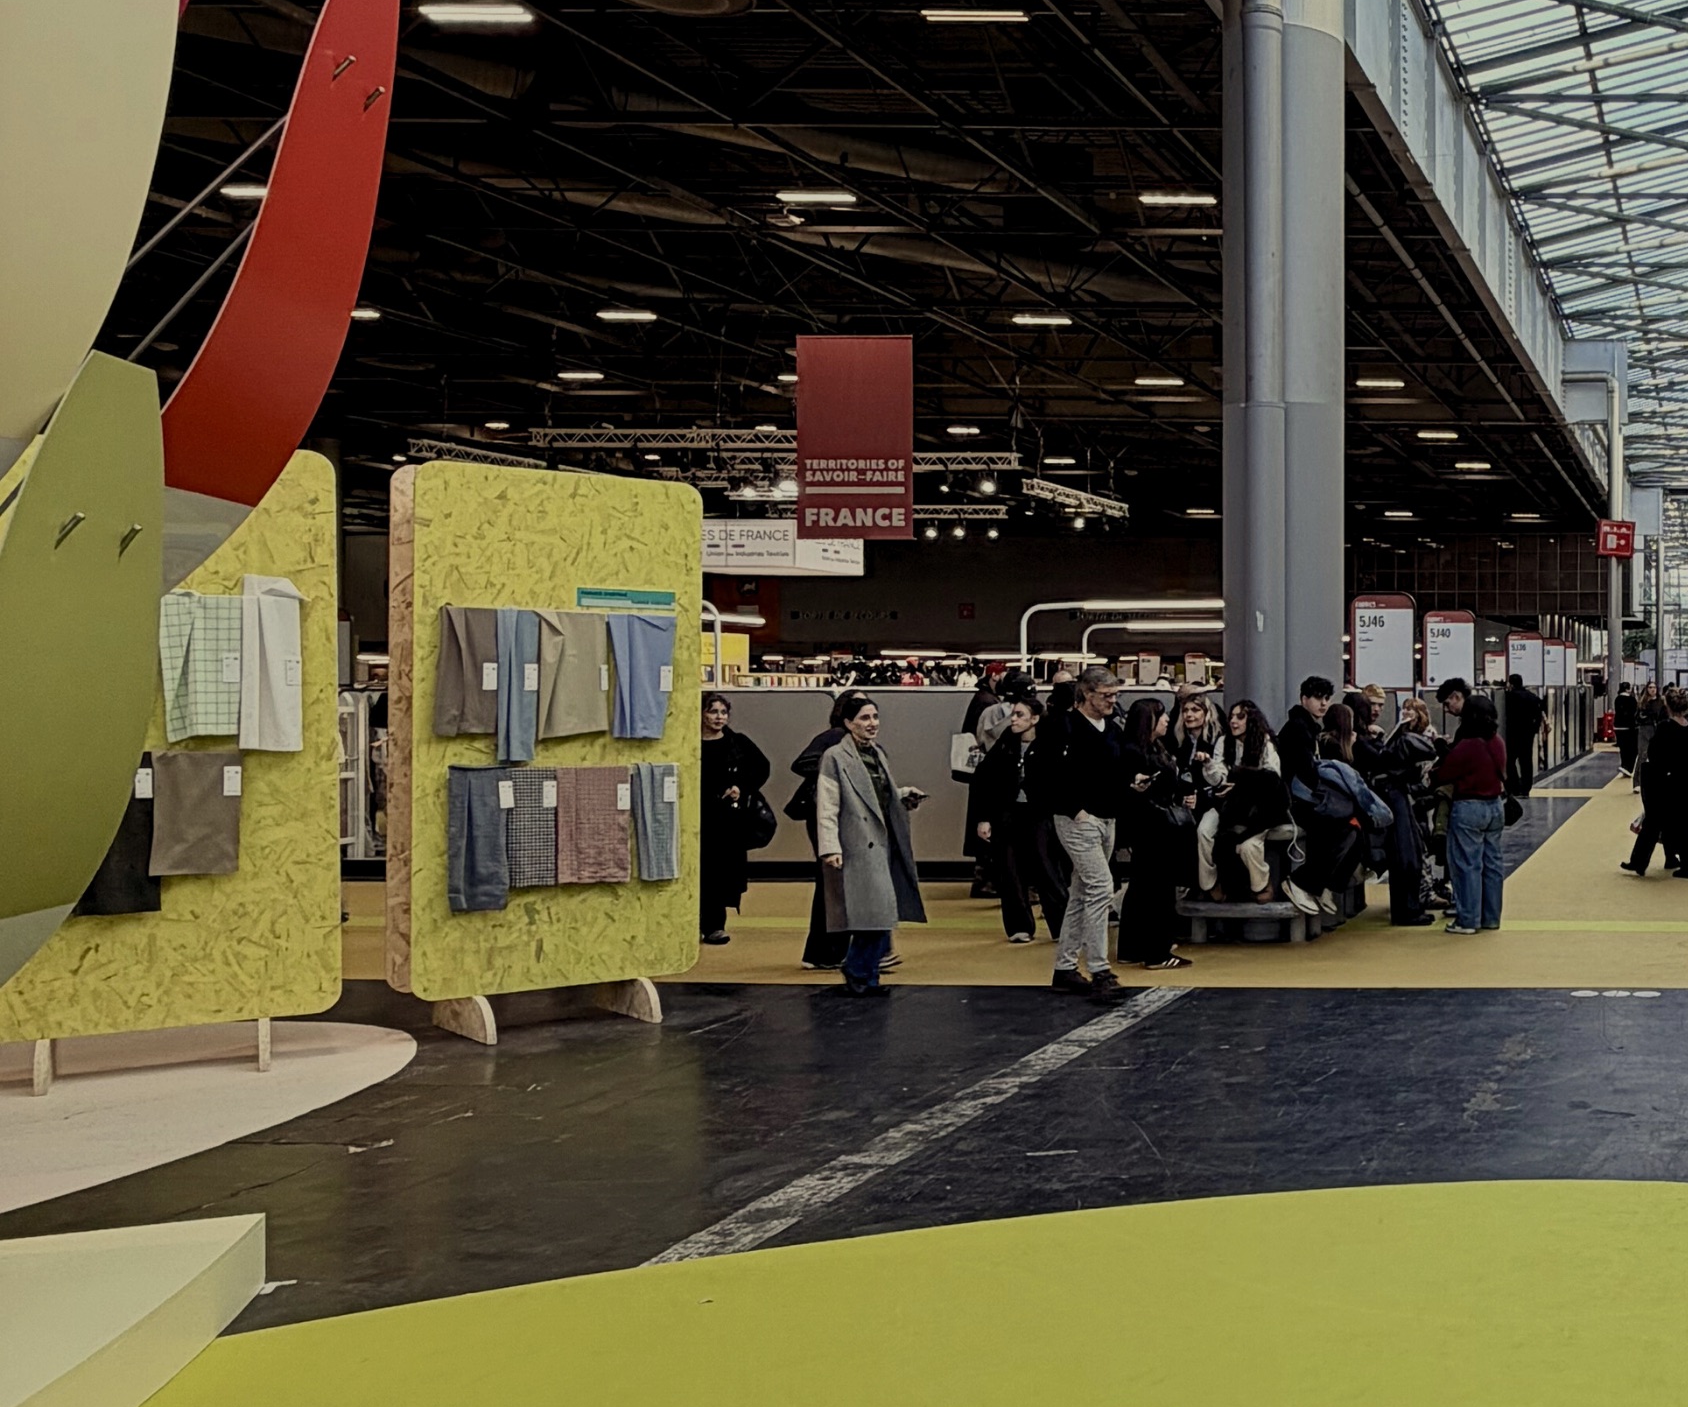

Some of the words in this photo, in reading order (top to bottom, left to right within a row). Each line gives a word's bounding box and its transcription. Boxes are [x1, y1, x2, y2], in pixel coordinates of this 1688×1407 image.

[804, 459, 885, 469] TERRITORIES
[886, 459, 905, 470] OF
[804, 470, 905, 482] SAVOIR-FAIRE
[804, 507, 906, 527] FRANCE
[719, 530, 735, 541] DE
[739, 530, 789, 541] FRANCE
[1358, 615, 1385, 628] 5J46
[1429, 628, 1451, 638] 5J40
